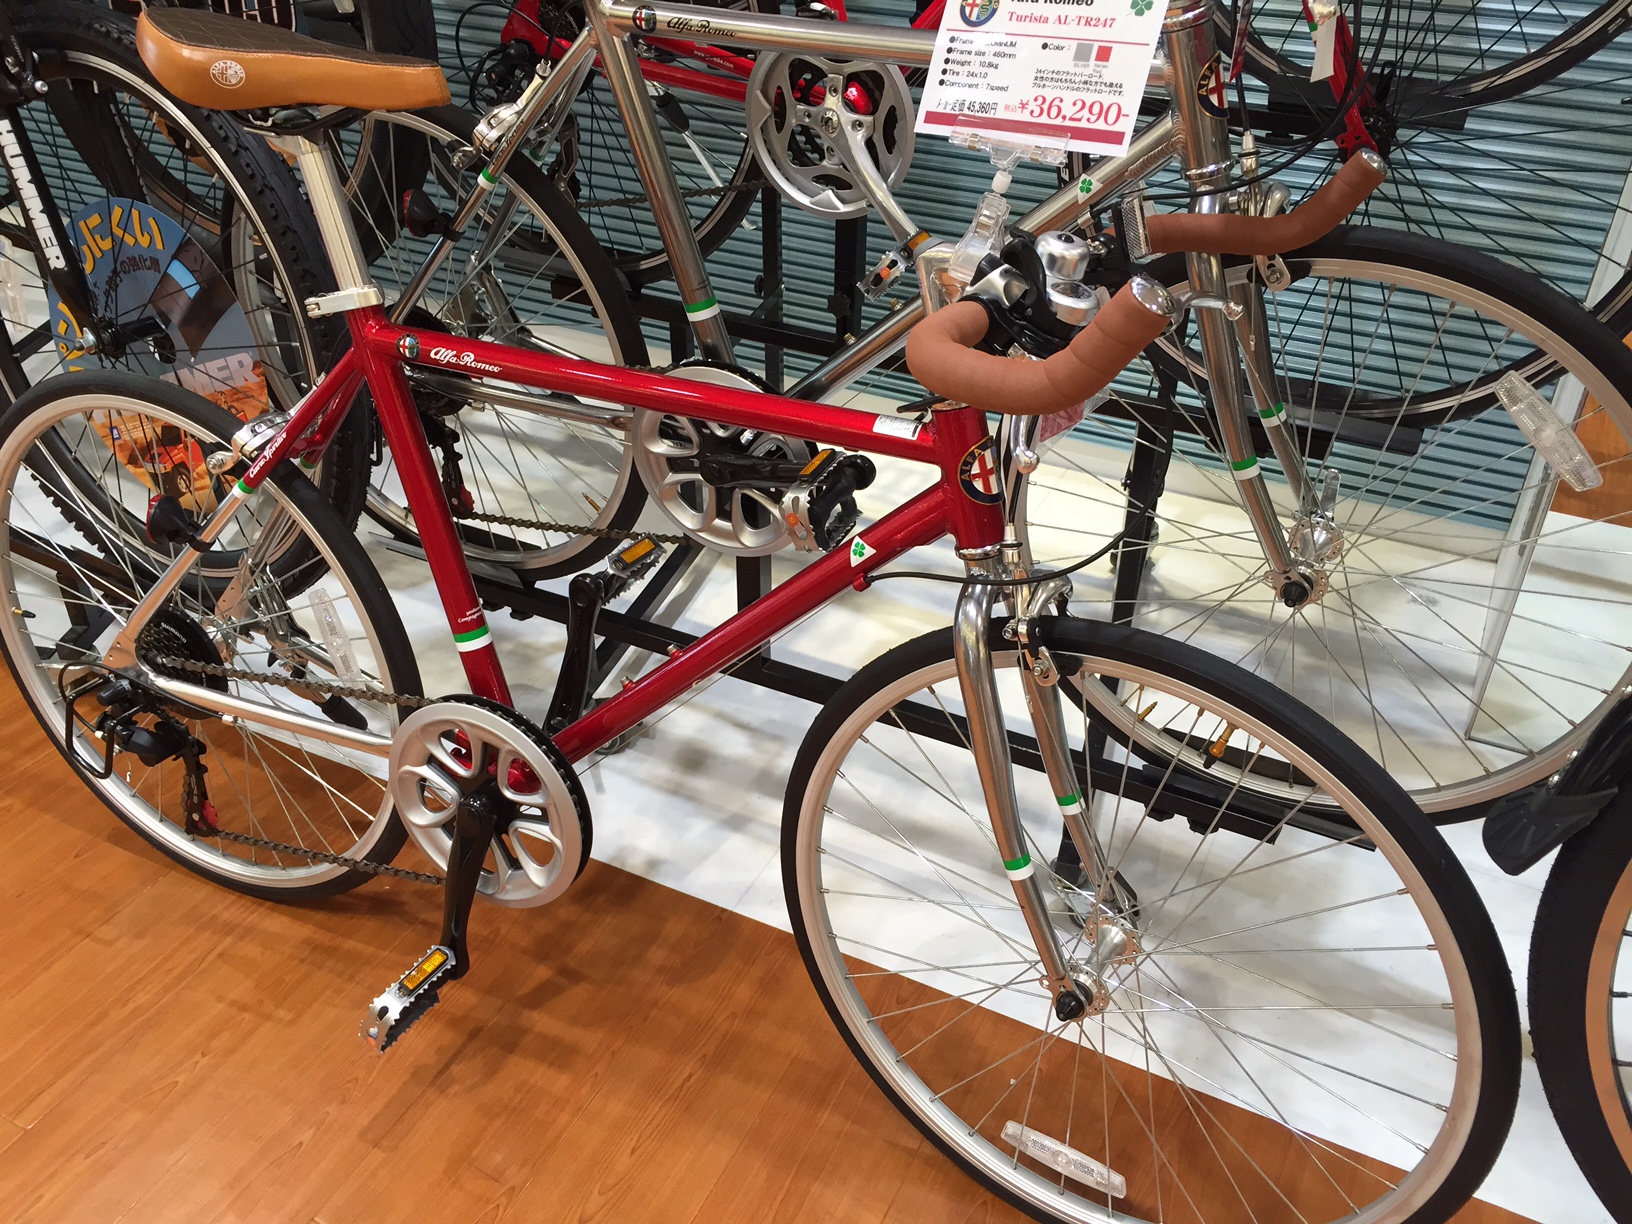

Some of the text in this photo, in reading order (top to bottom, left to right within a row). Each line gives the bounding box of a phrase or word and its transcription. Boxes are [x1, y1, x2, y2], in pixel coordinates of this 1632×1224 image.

[667, 16, 737, 38] Alfa Romeo
[1008, 11, 1117, 29] Turista AL-TR247
[951, 48, 973, 57] Frame
[974, 49, 987, 58] size
[992, 51, 1017, 60] 460mm
[1048, 43, 1066, 52] Color
[950, 58, 972, 67] Weight
[978, 60, 1000, 70] 10.8kg
[948, 68, 960, 77] Tire
[966, 71, 988, 79] 24x1.0
[1198, 60, 1218, 96] ALFA
[985, 83, 1009, 92] 7speed
[1003, 103, 1017, 113] 税込
[0, 119, 66, 270] HUMMER
[429, 347, 503, 373] Alfa Romeo
[961, 448, 983, 481] ALFA
